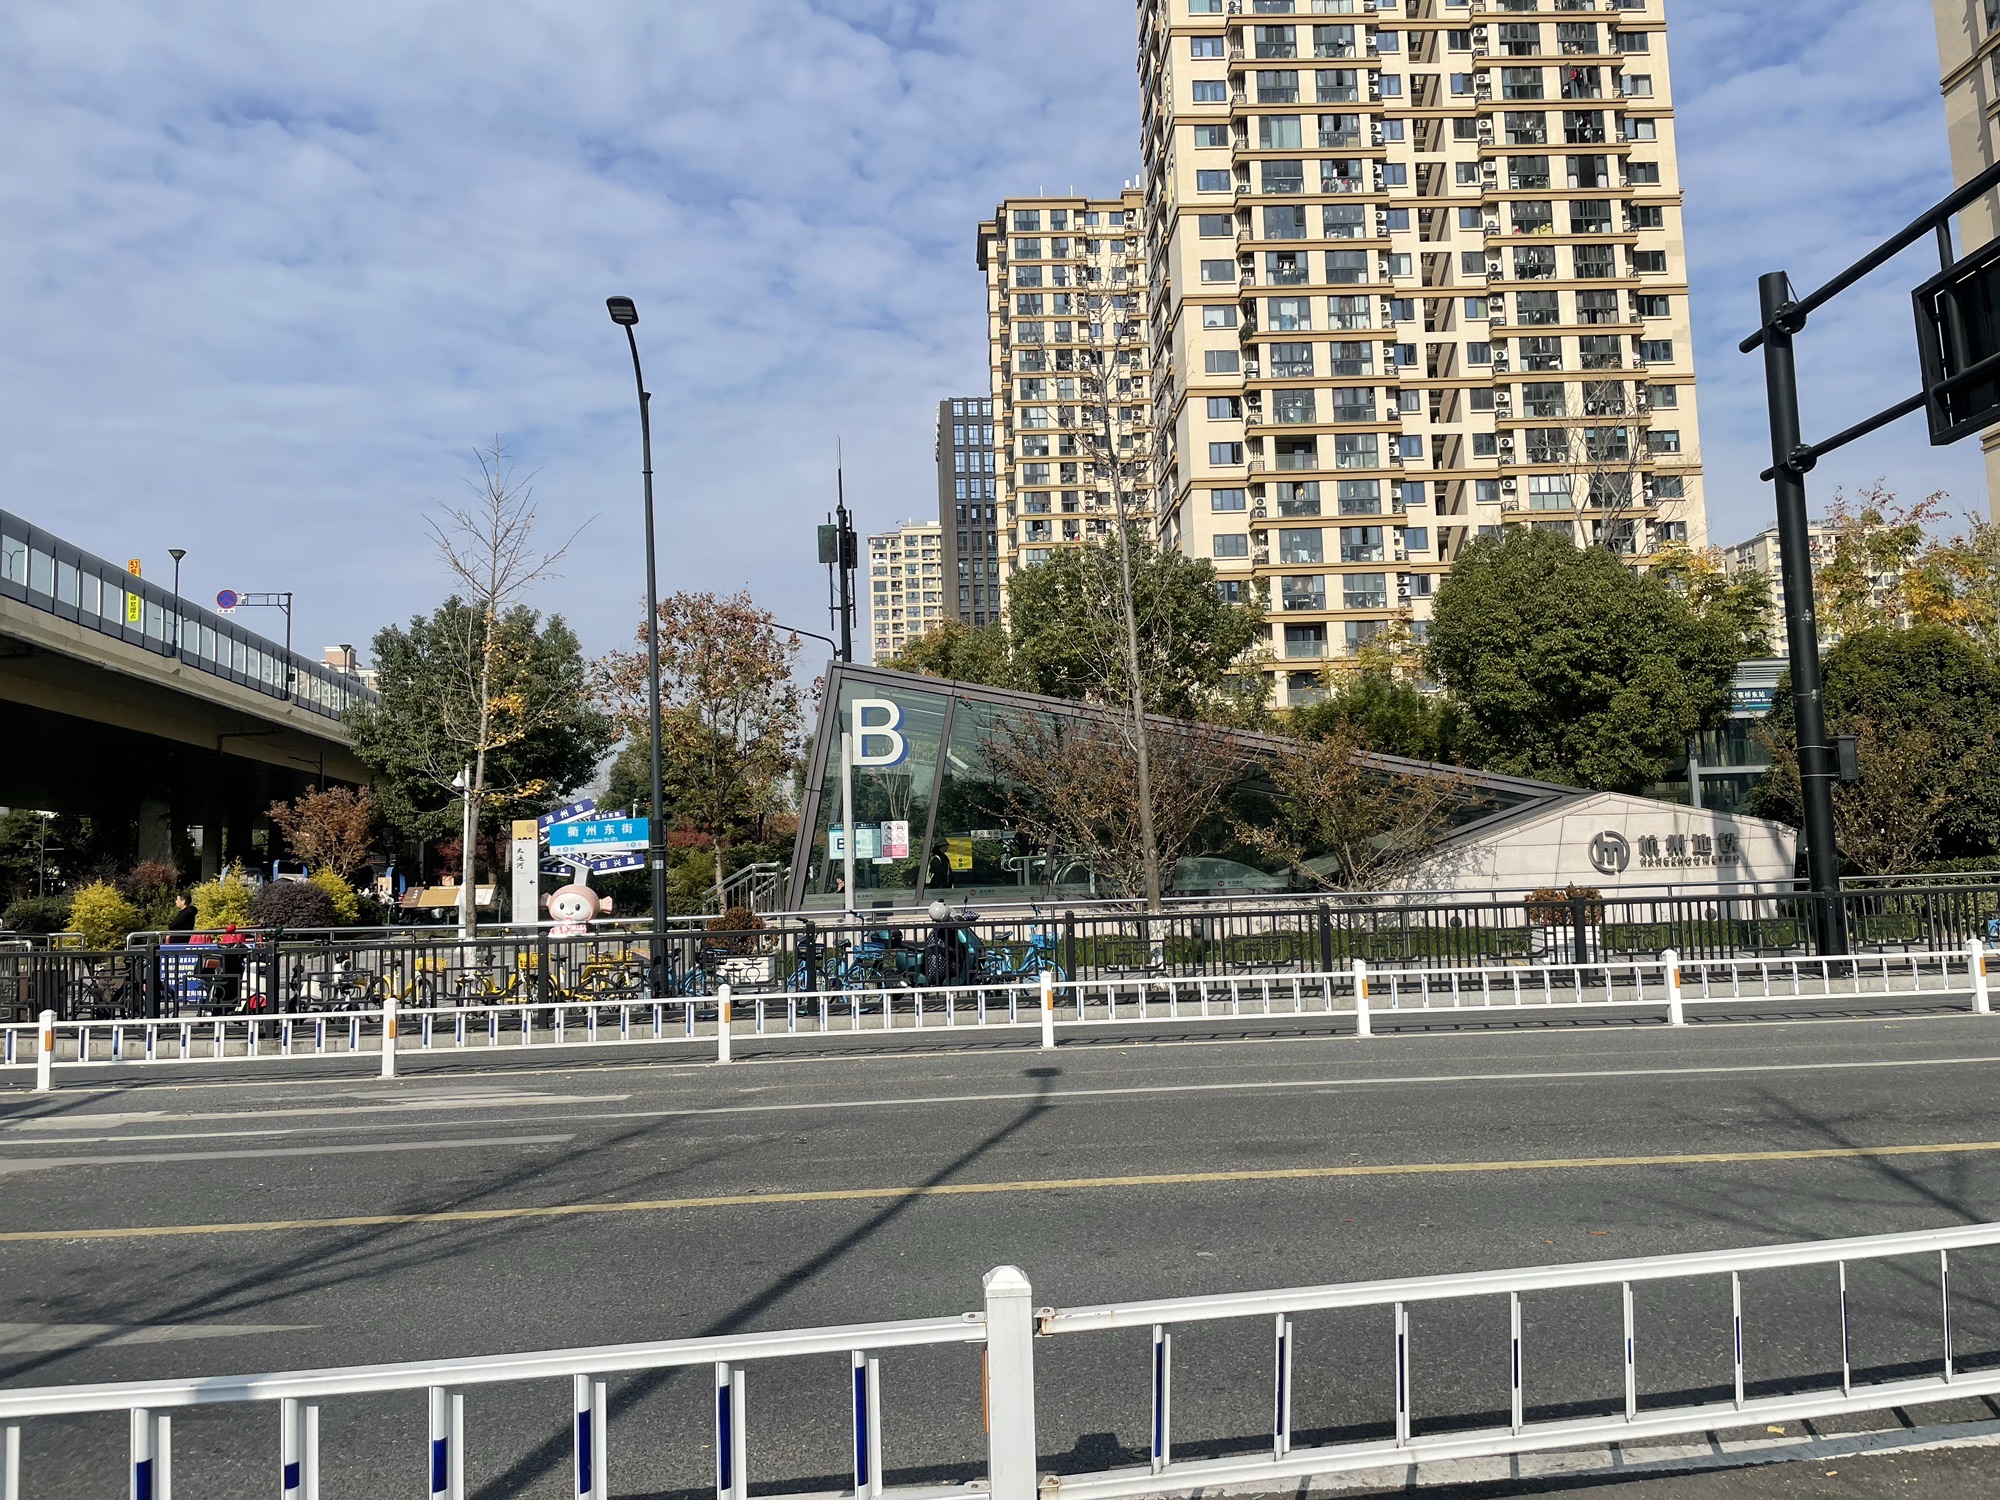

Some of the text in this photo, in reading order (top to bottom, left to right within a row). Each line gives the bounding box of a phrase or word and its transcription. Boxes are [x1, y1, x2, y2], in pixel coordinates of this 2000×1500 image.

[852, 699, 908, 767] B
[544, 803, 584, 825] 湖州街
[567, 823, 633, 838] 衢州东街
[1638, 833, 1739, 857] 杭州地铁
[516, 847, 526, 870] 大运河
[600, 857, 635, 869] 绍兴路
